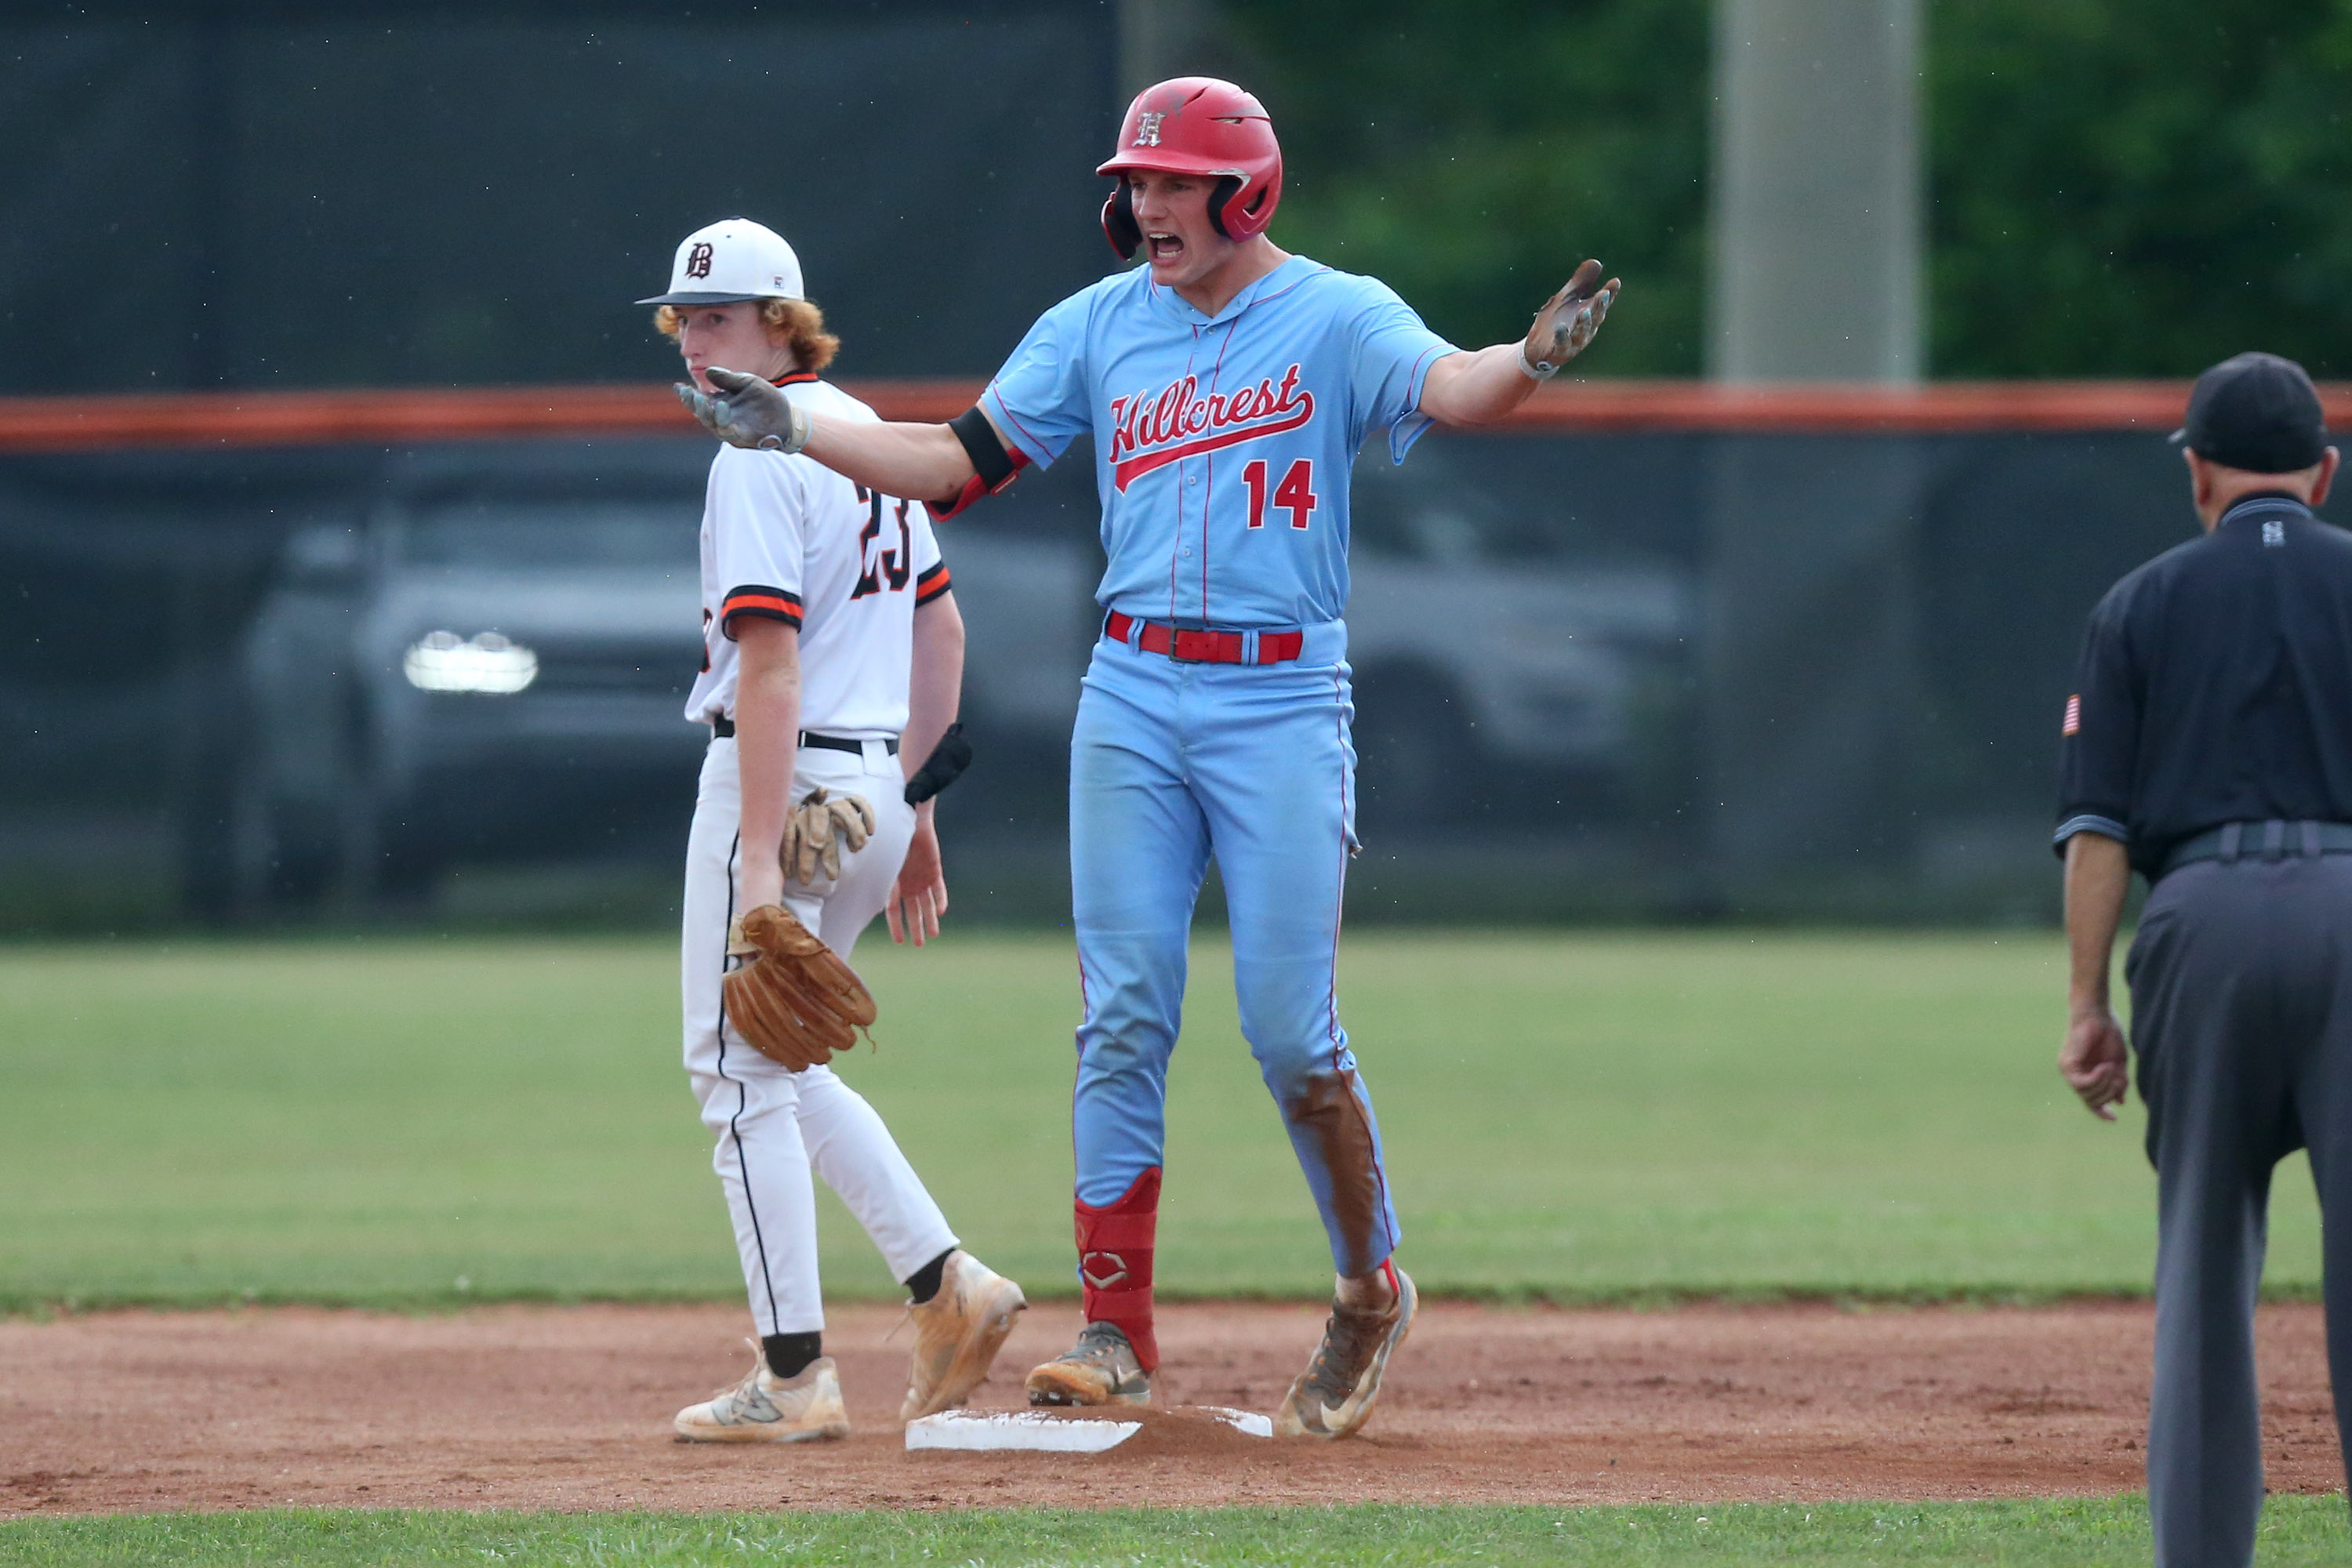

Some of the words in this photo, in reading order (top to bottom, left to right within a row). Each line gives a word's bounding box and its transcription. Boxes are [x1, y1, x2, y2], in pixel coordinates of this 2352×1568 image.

[1131, 111, 1167, 147] H
[684, 242, 713, 279] B
[1109, 363, 1312, 466] Hillcrest
[1241, 458, 1317, 531] 14
[850, 481, 910, 600] 23
